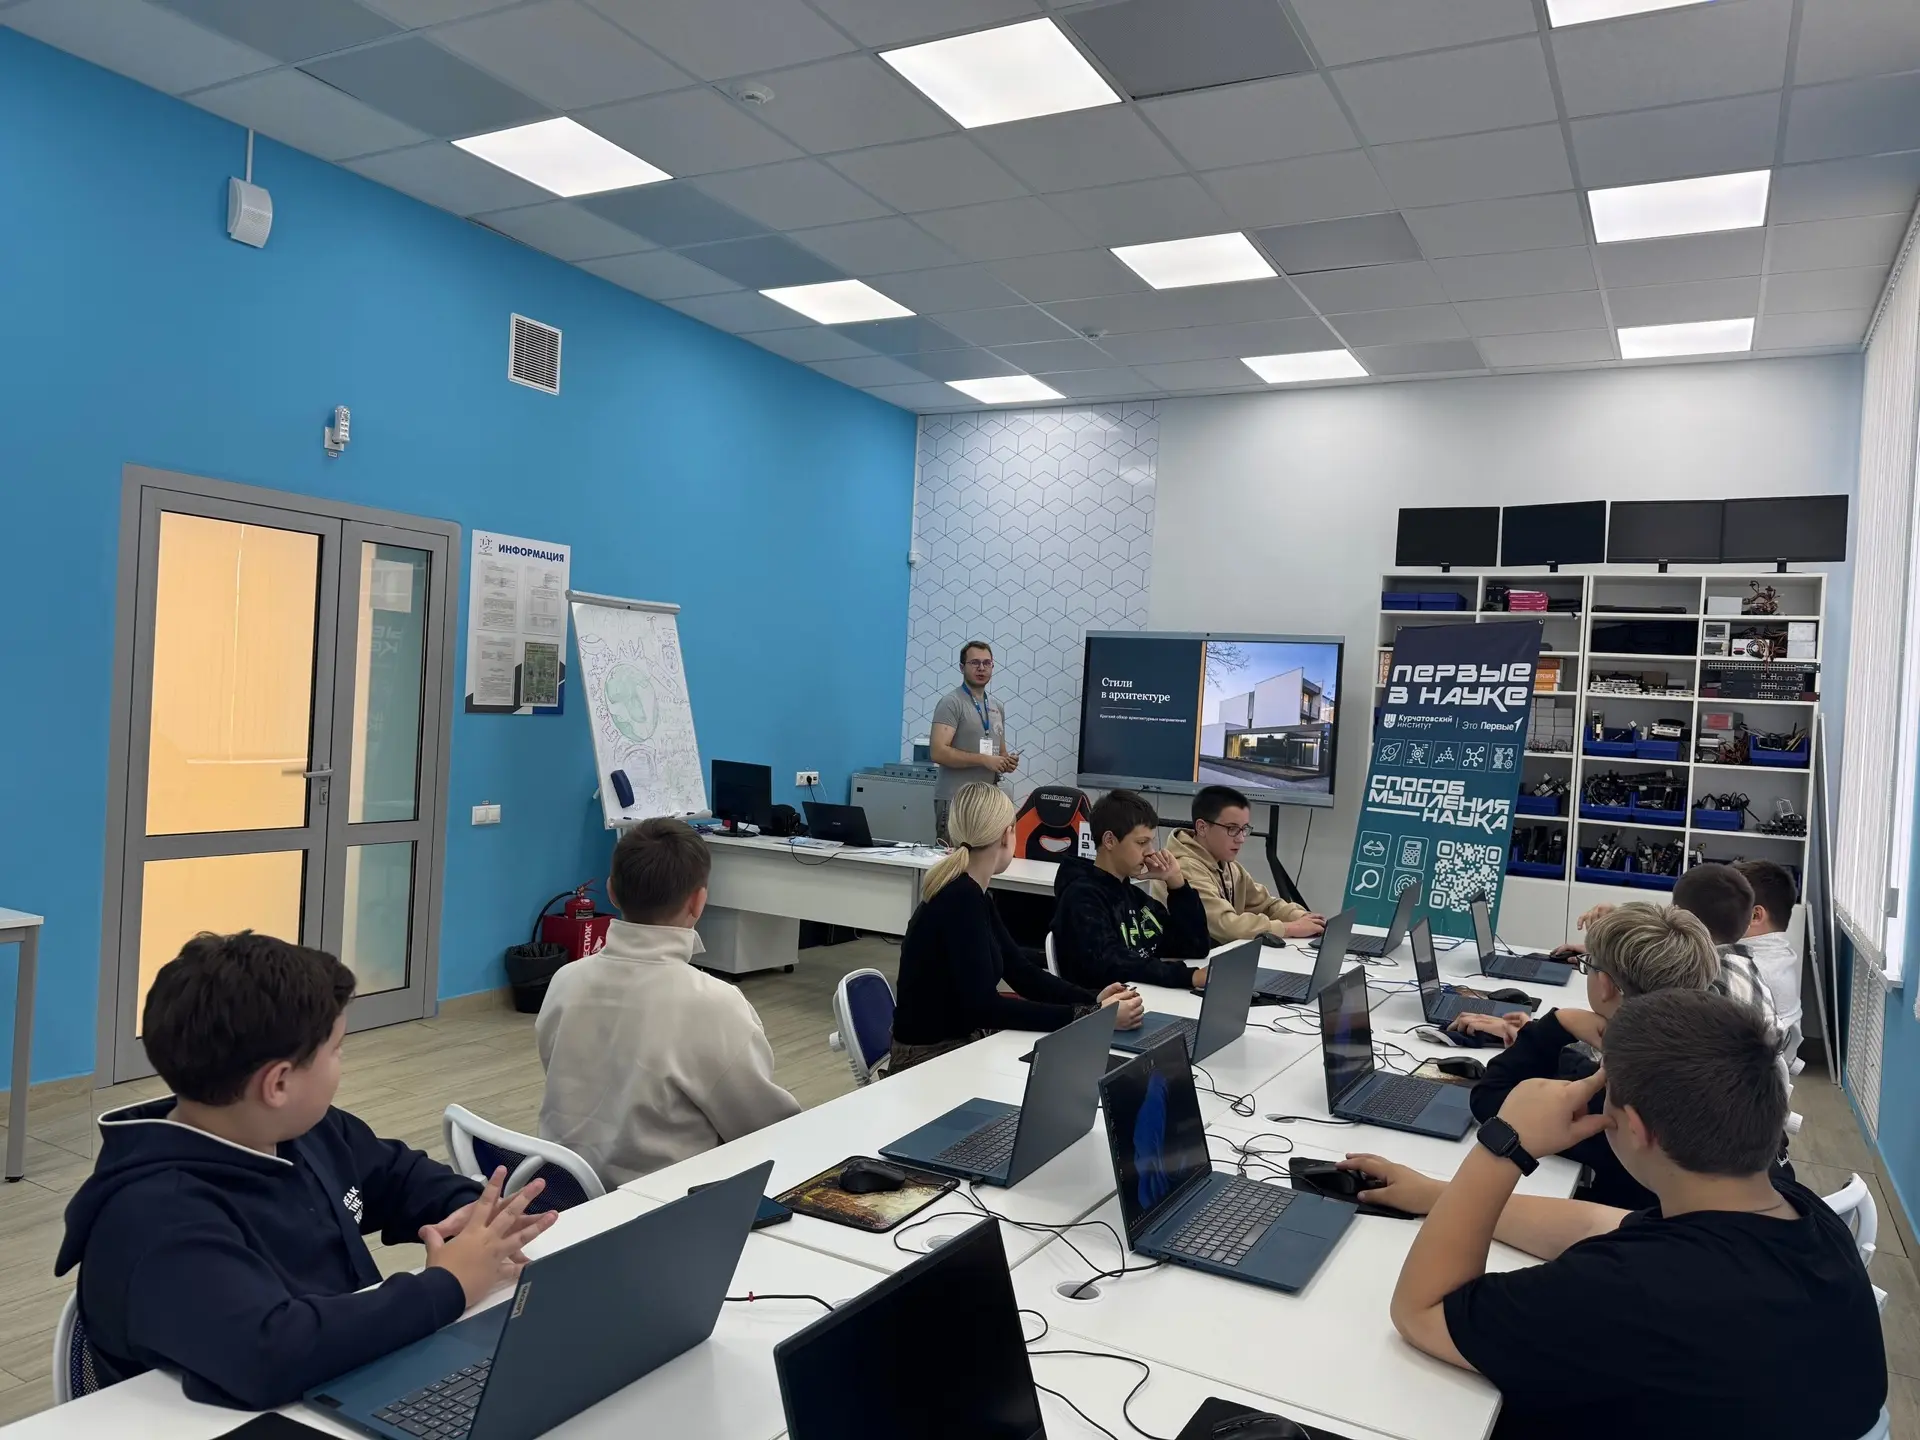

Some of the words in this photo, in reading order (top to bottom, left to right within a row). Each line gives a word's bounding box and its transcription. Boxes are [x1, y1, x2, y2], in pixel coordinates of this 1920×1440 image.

[498, 543, 565, 562] ИНФОРМАЦИЯ
[1391, 662, 1532, 683] ПЕРВЫЕ
[1101, 677, 1133, 688] Стили
[1101, 691, 1107, 699] в
[1108, 691, 1171, 704] архитектуре
[1418, 686, 1528, 713] НАУКЕ
[1396, 722, 1432, 731] институт
[1398, 714, 1453, 724] Курчатовский
[1461, 720, 1478, 730] Это
[1371, 774, 1466, 796] СПОСОБ
[1367, 788, 1511, 815] МЫШЛЕНИЯ
[1421, 807, 1509, 835] НАУКА
[582, 921, 593, 958] ЕСТИЖ
[348, 1196, 363, 1213] THE
